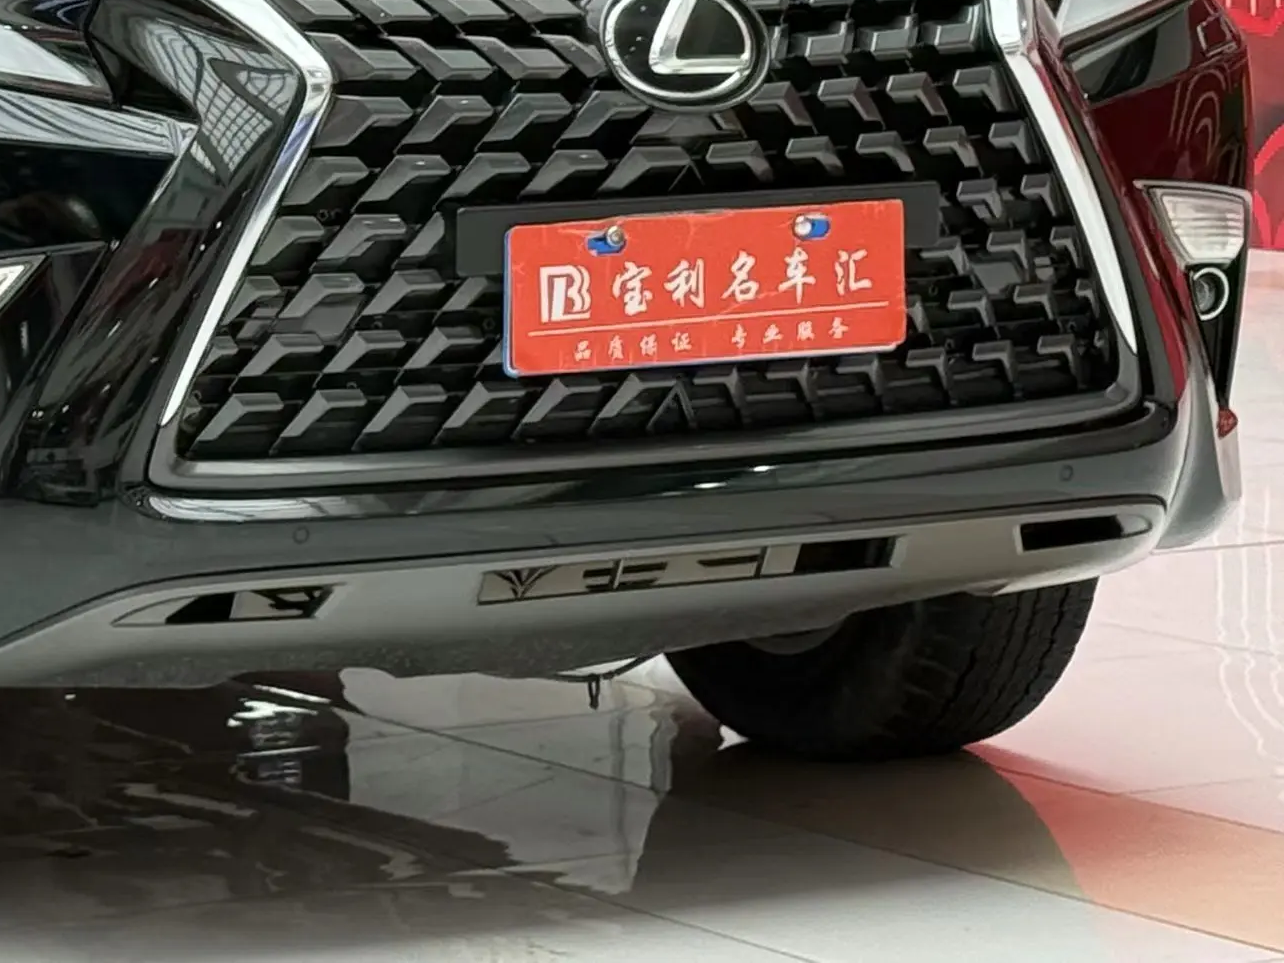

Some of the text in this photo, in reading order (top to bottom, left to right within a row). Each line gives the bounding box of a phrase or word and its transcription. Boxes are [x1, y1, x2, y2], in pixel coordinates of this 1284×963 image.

[612, 246, 873, 317] 宝利名车汇
[573, 316, 849, 362] 品质保证 专业服务
